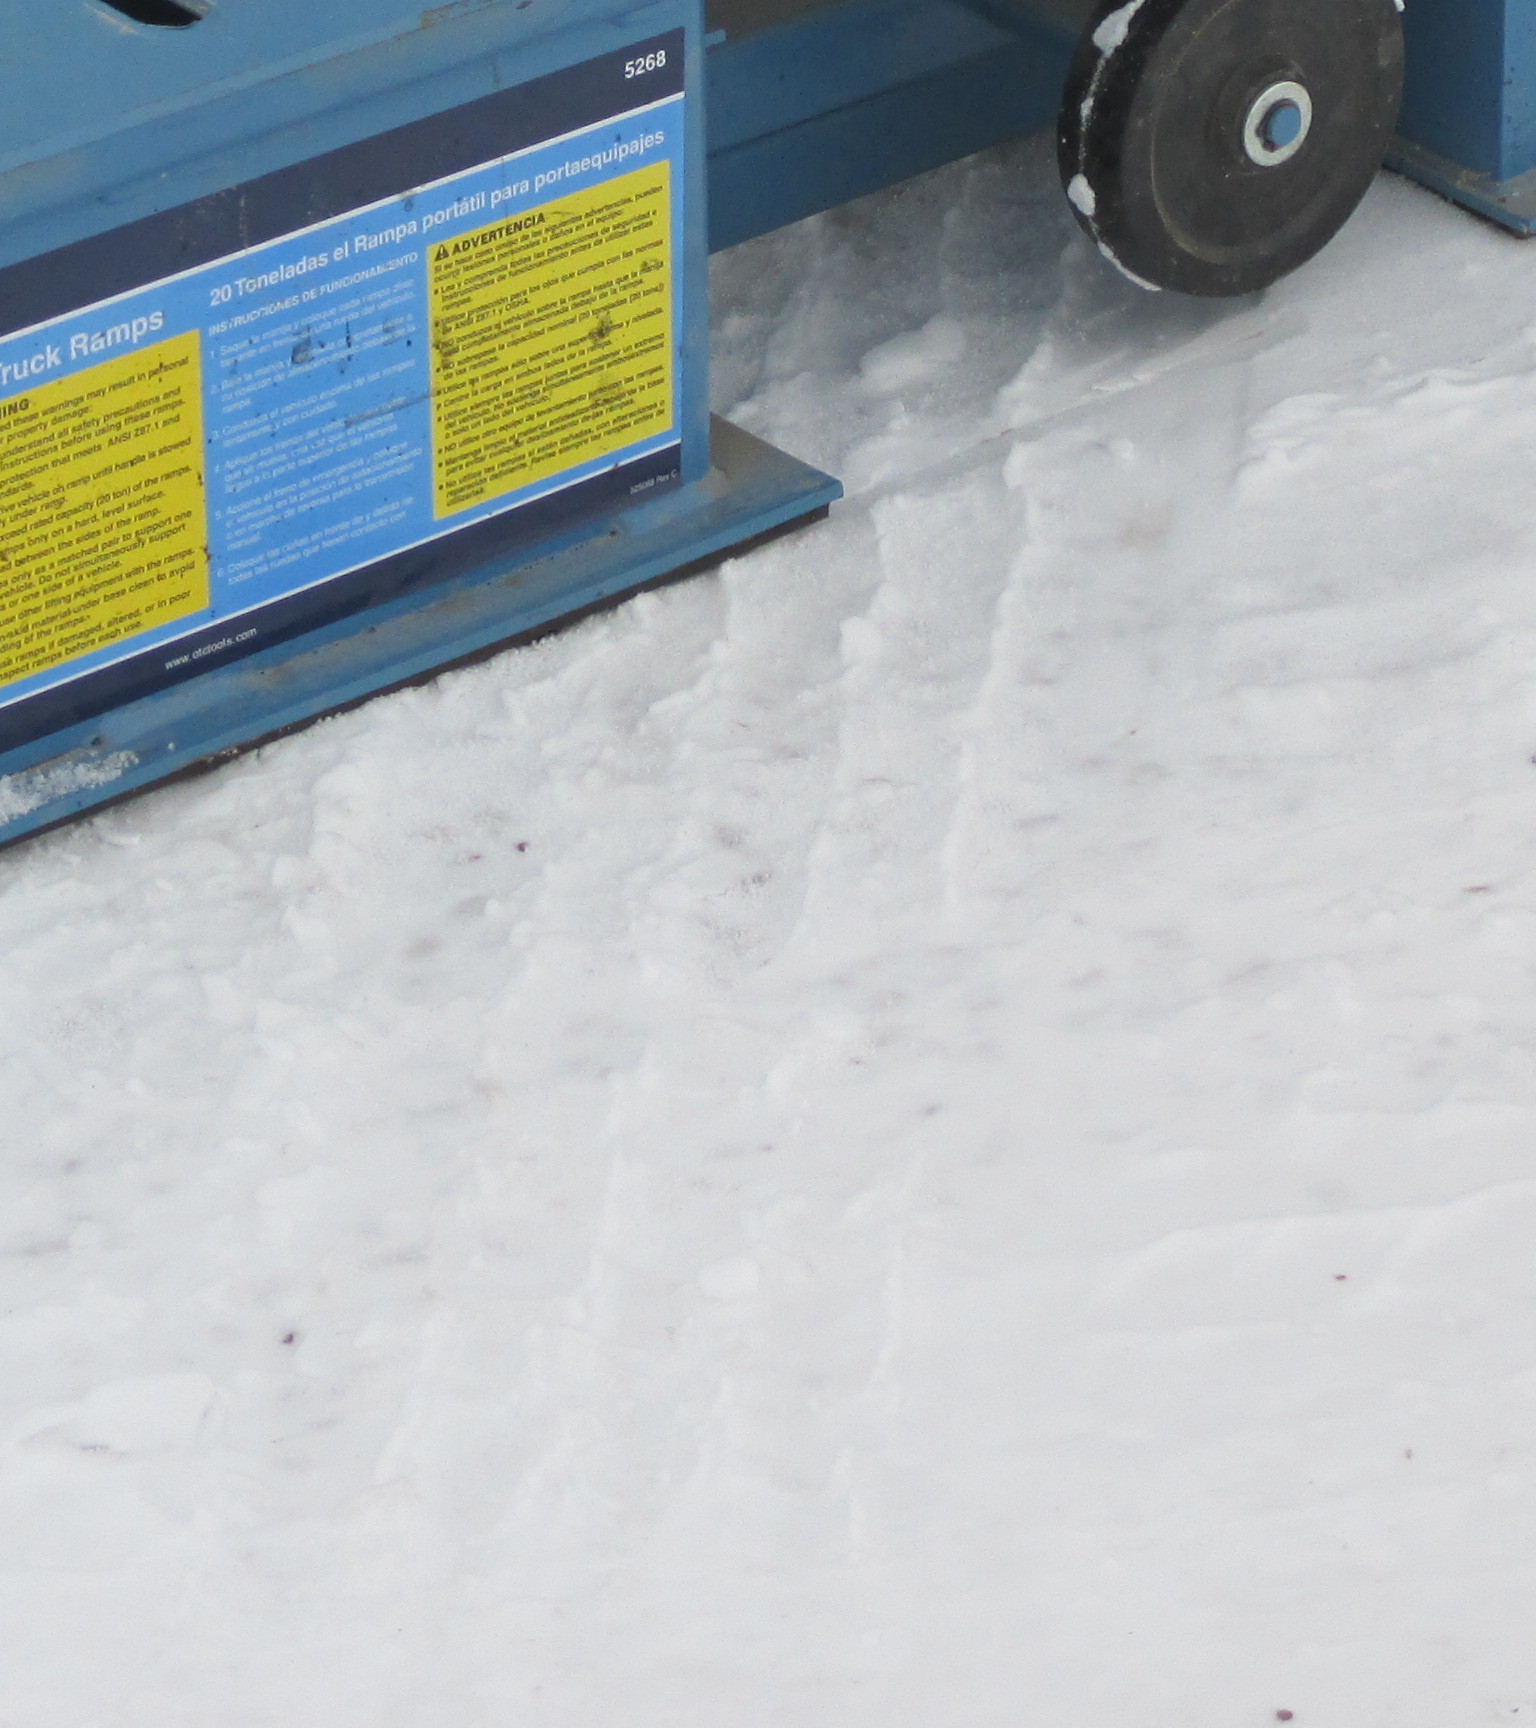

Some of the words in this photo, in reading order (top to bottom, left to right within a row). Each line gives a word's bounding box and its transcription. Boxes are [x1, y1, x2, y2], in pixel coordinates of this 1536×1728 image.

[624, 48, 665, 80] 5268
[209, 282, 232, 308] 20
[235, 250, 329, 298] Toneladas
[332, 238, 350, 263] el
[353, 218, 417, 255] Rampa
[421, 188, 486, 236] portátil
[490, 177, 530, 211] para
[533, 128, 663, 195] portaequipajes
[452, 210, 545, 256] ADVERTENCIA
[68, 309, 163, 361] Ramps
